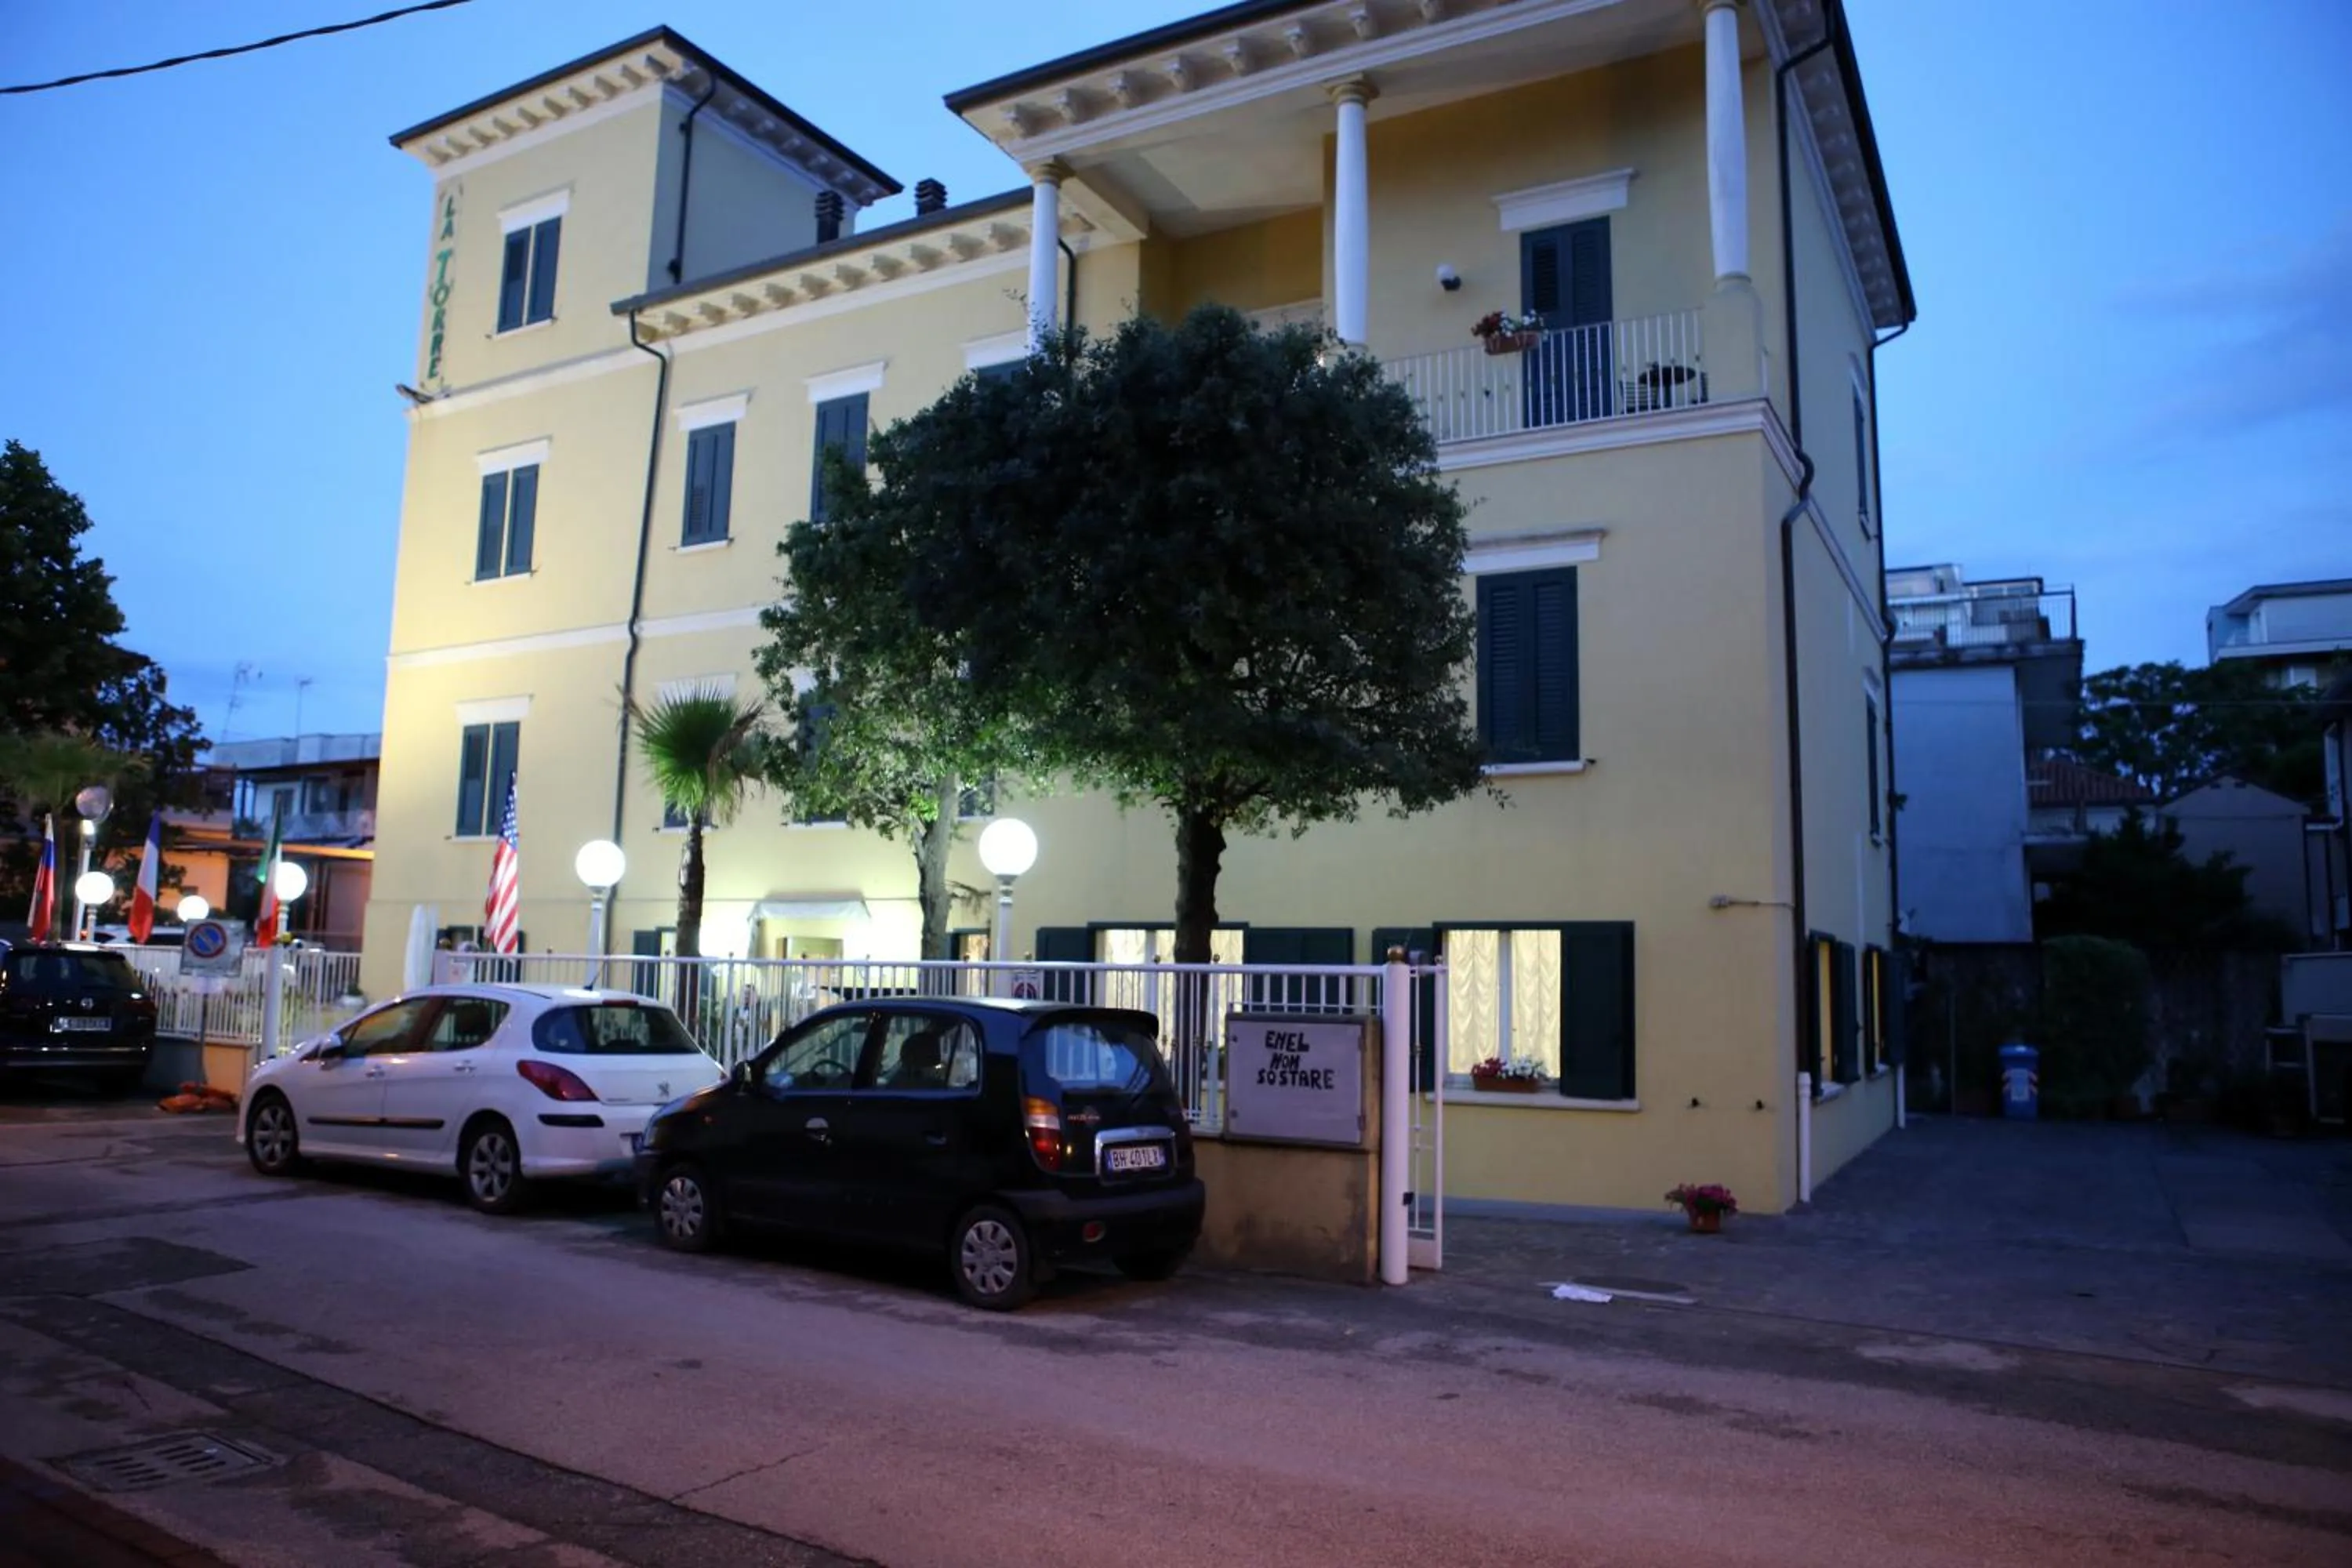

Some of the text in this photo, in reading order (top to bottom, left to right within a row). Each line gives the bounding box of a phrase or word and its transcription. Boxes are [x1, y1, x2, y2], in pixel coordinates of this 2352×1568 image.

[428, 194, 455, 379] LA TORRE
[1265, 1030, 1310, 1052] ENEL
[1257, 1067, 1335, 1090] SOSTARE
